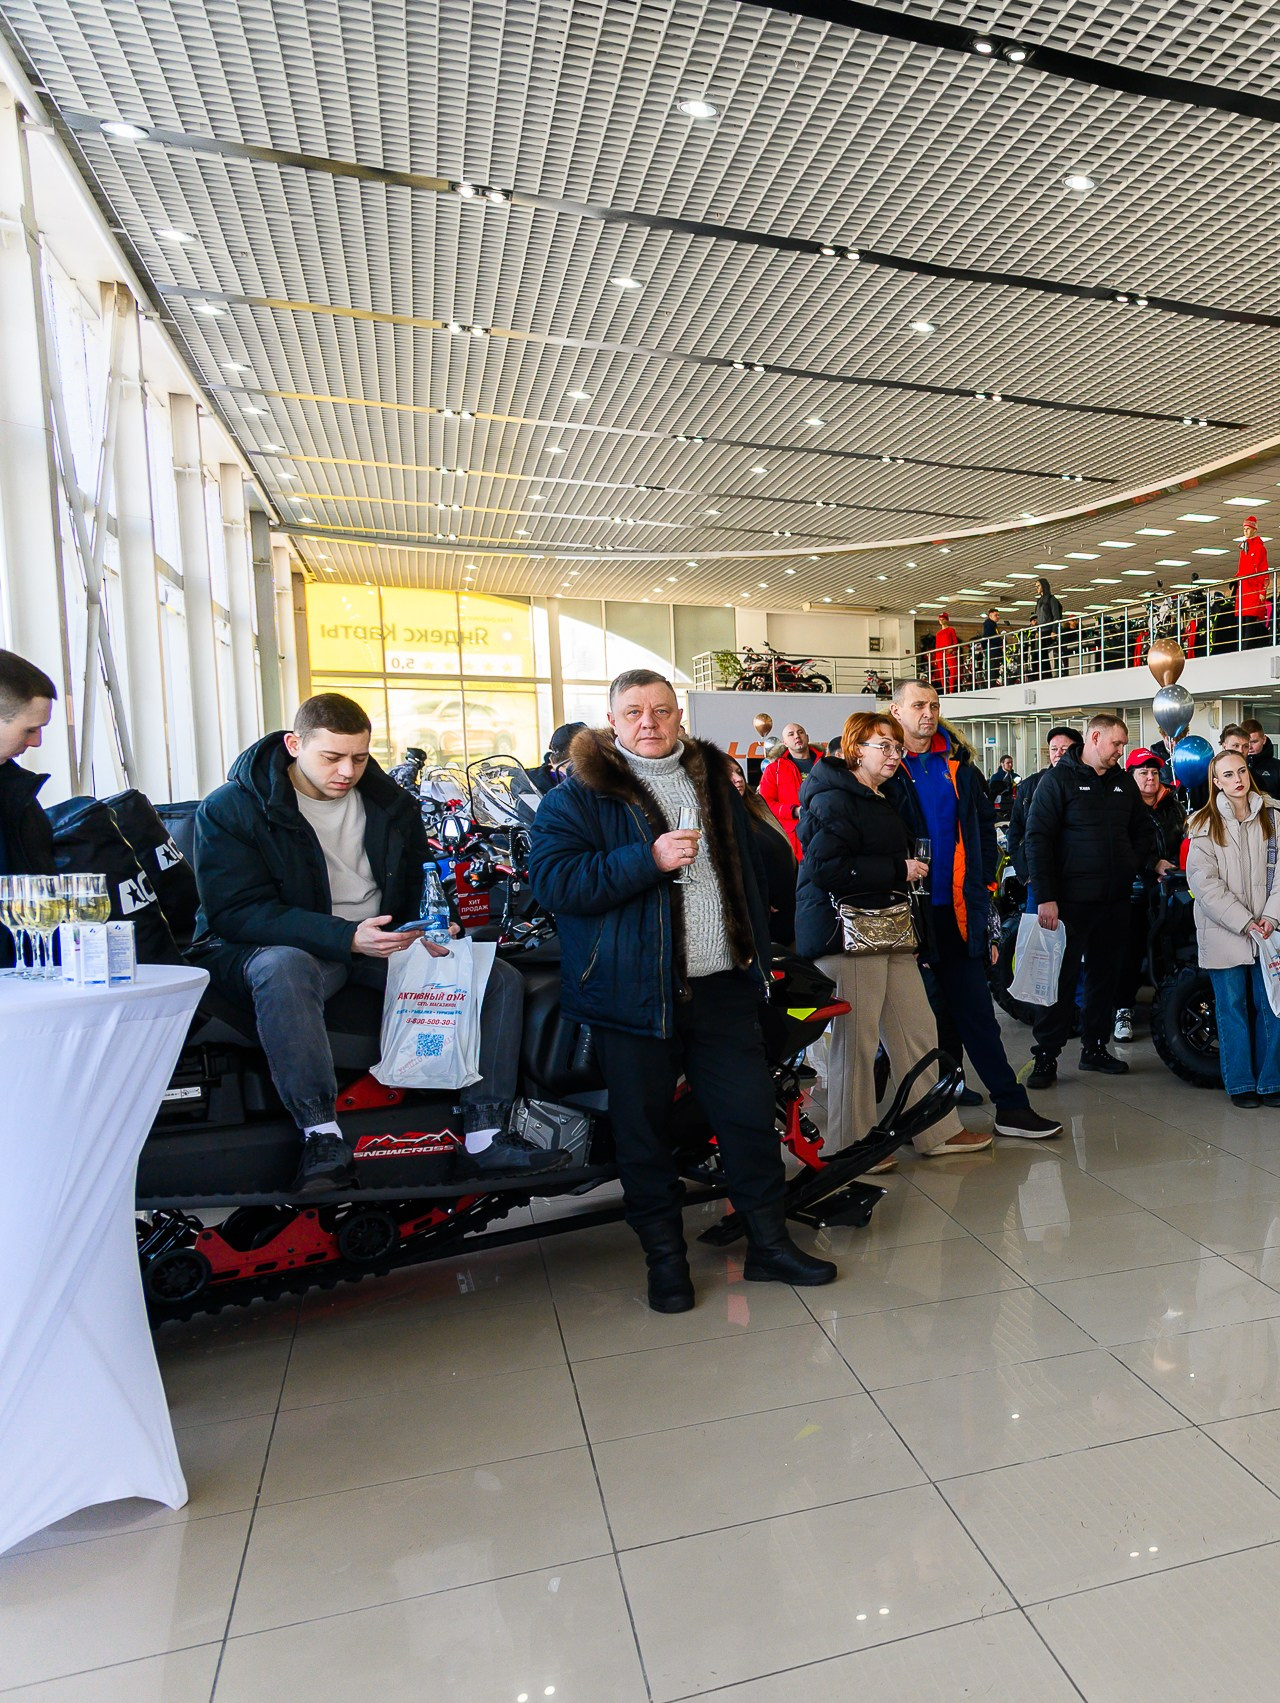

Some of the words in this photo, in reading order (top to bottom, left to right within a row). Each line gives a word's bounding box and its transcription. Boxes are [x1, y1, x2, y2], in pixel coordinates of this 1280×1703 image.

[461, 904, 489, 913] ПРОДАЖ
[397, 991, 446, 1001] АКТИВНЫЙ
[353, 1144, 455, 1158] SNOWCROSS
